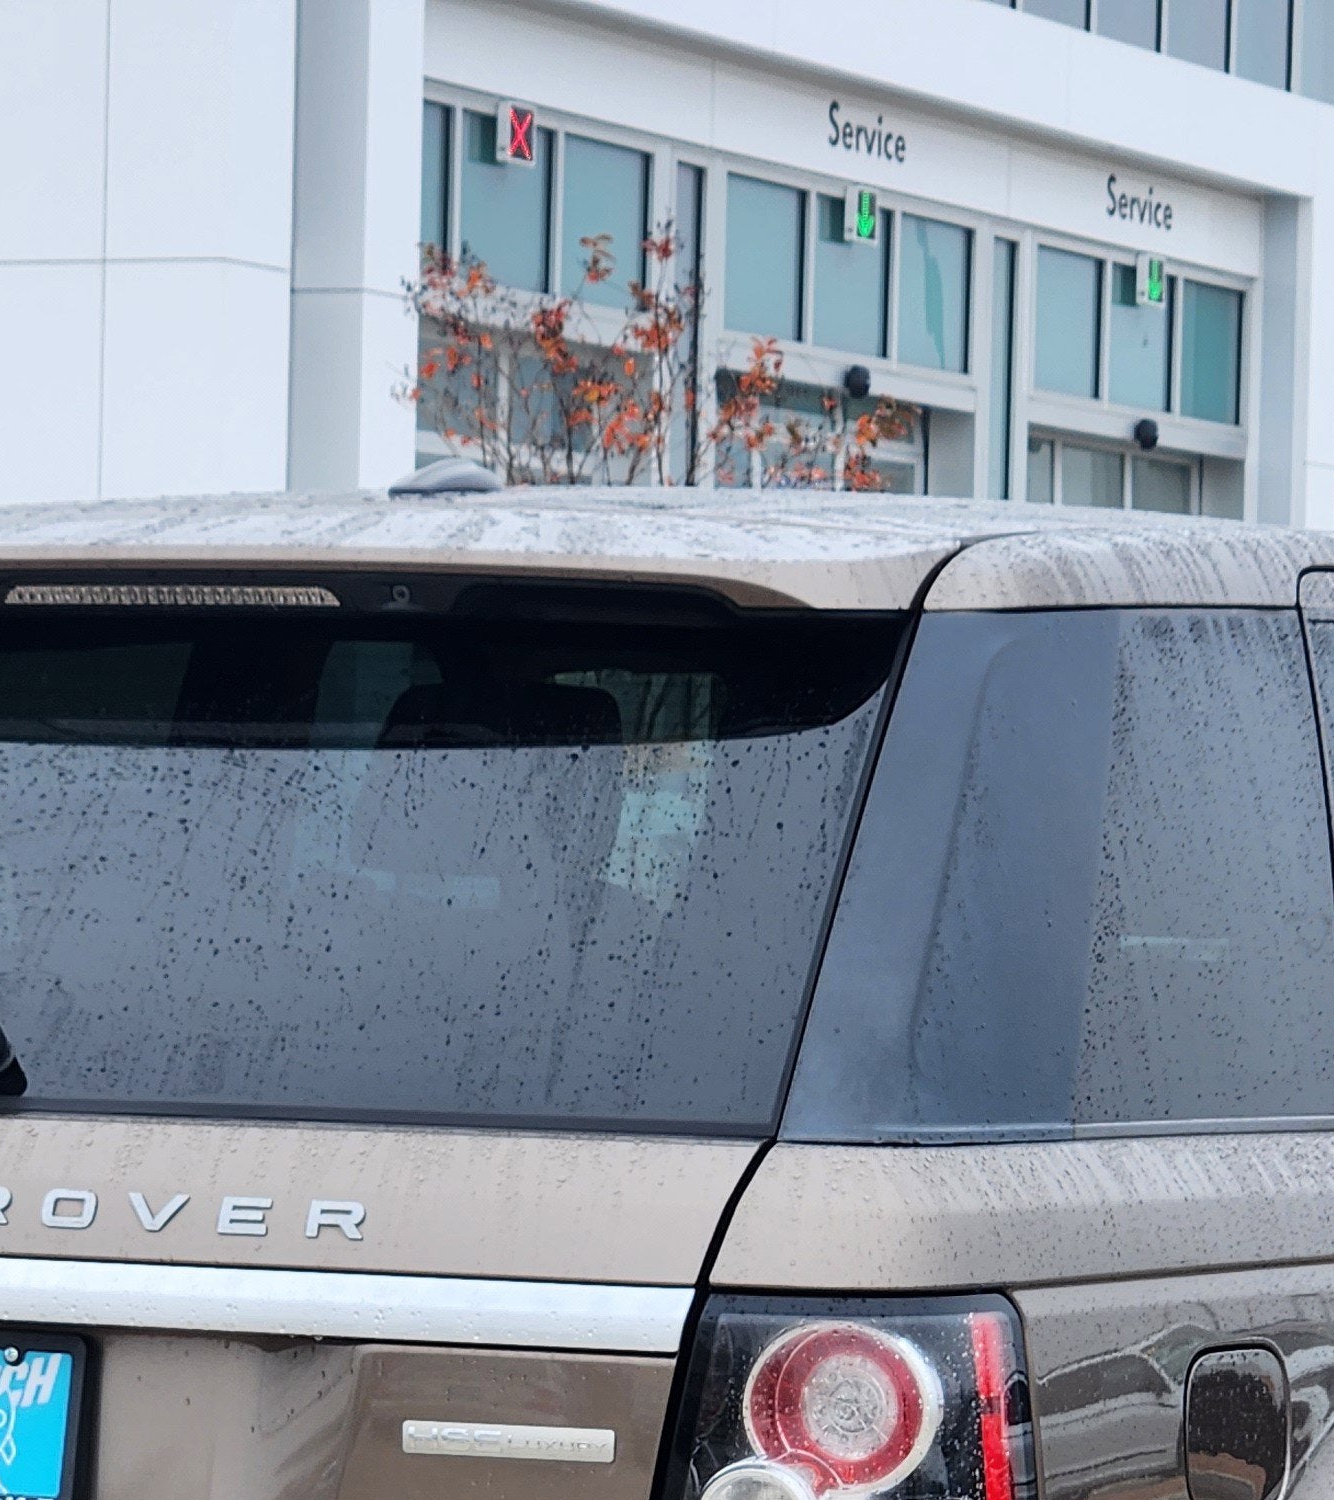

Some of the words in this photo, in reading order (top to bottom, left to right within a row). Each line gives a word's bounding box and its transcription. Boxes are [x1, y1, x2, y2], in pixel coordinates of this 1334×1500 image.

[828, 99, 906, 163] Service
[1106, 172, 1173, 231] Service
[407, 1424, 502, 1453] HSE
